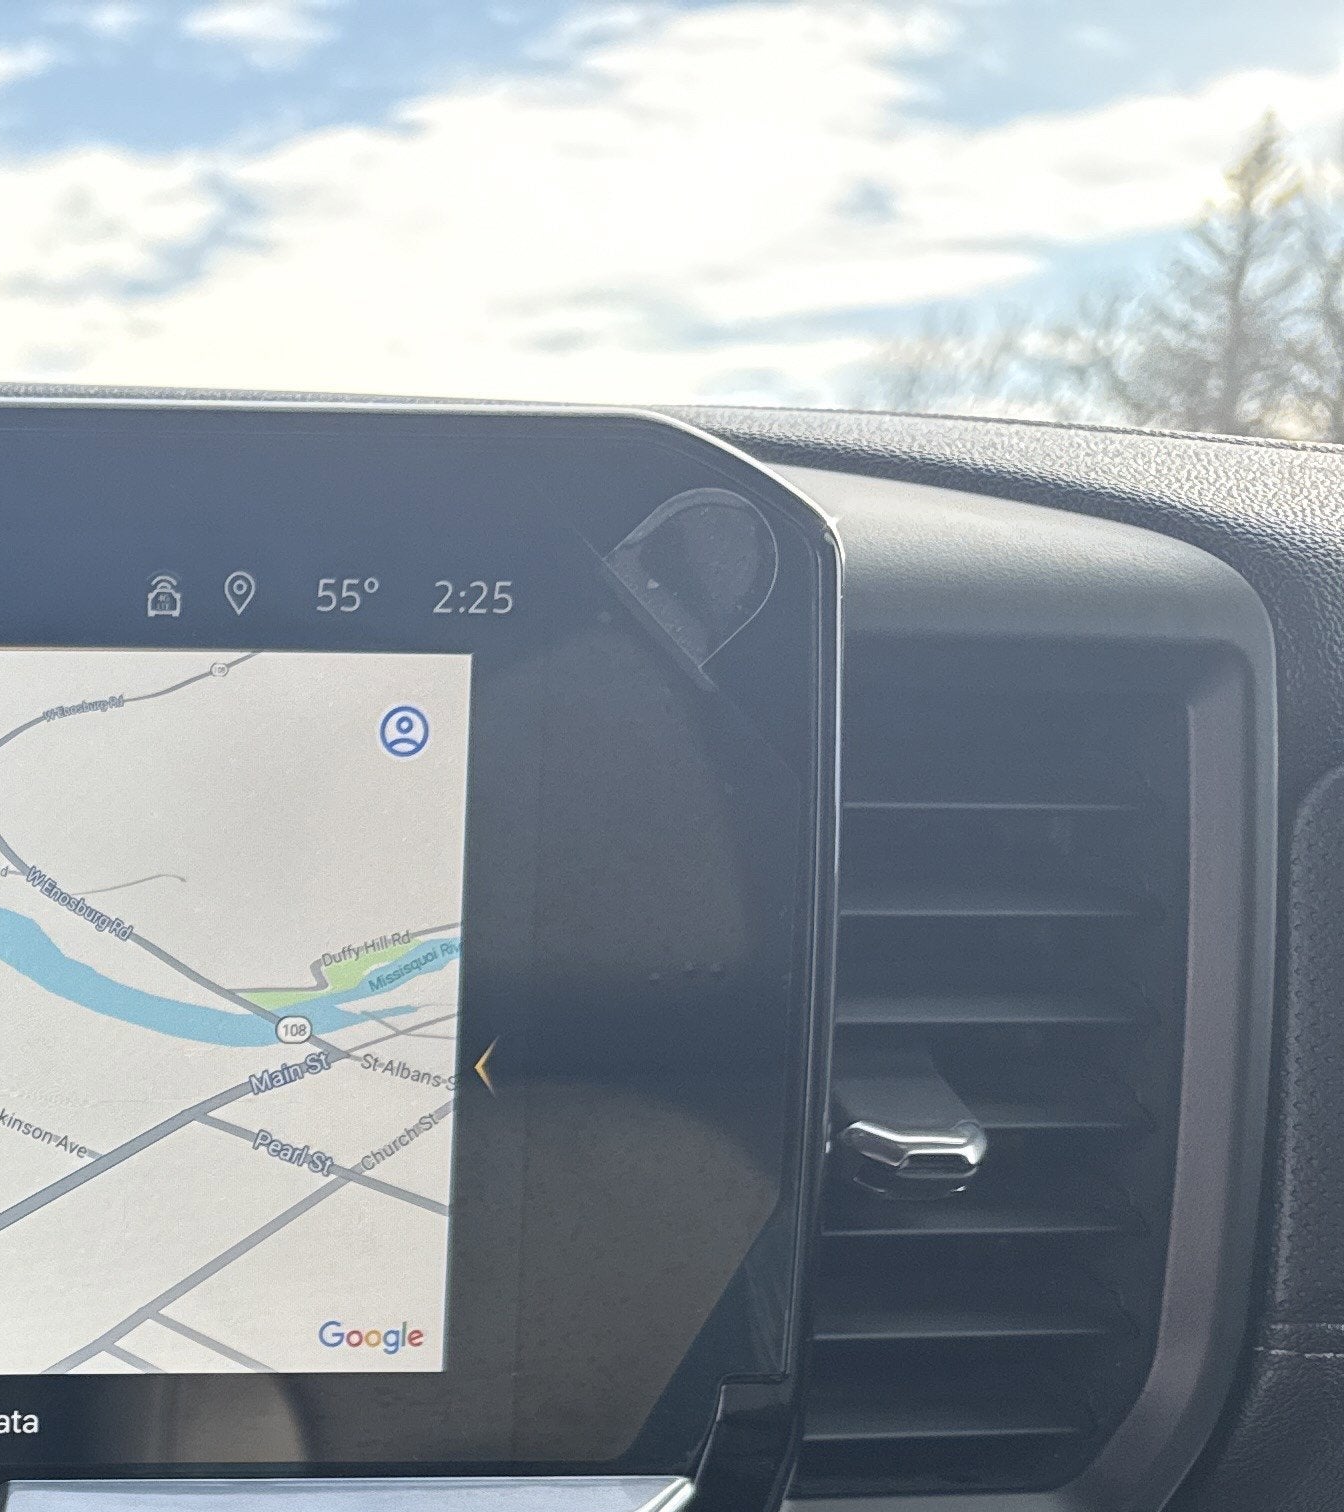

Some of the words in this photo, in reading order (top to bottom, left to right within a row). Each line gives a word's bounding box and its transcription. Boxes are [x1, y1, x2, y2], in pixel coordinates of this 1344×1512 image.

[316, 577, 379, 612] 55°
[433, 579, 513, 614] 2:25
[27, 866, 44, 887] W
[41, 878, 113, 932] Enosburg
[109, 917, 134, 941] Rd
[321, 943, 362, 967] Duffy
[364, 937, 388, 955] Hill
[391, 930, 411, 946] Rd
[368, 946, 440, 992] Missisquoi
[283, 1022, 308, 1037] 108
[249, 1062, 305, 1095] Main
[304, 1051, 332, 1075] St
[361, 1053, 380, 1070] St
[381, 1059, 442, 1090] Albans
[55, 1134, 88, 1159] Ave
[252, 1129, 310, 1167] Pearl
[308, 1150, 335, 1177] St
[361, 1127, 418, 1172] Church
[418, 1112, 439, 1131] St
[318, 1320, 424, 1357] Google
